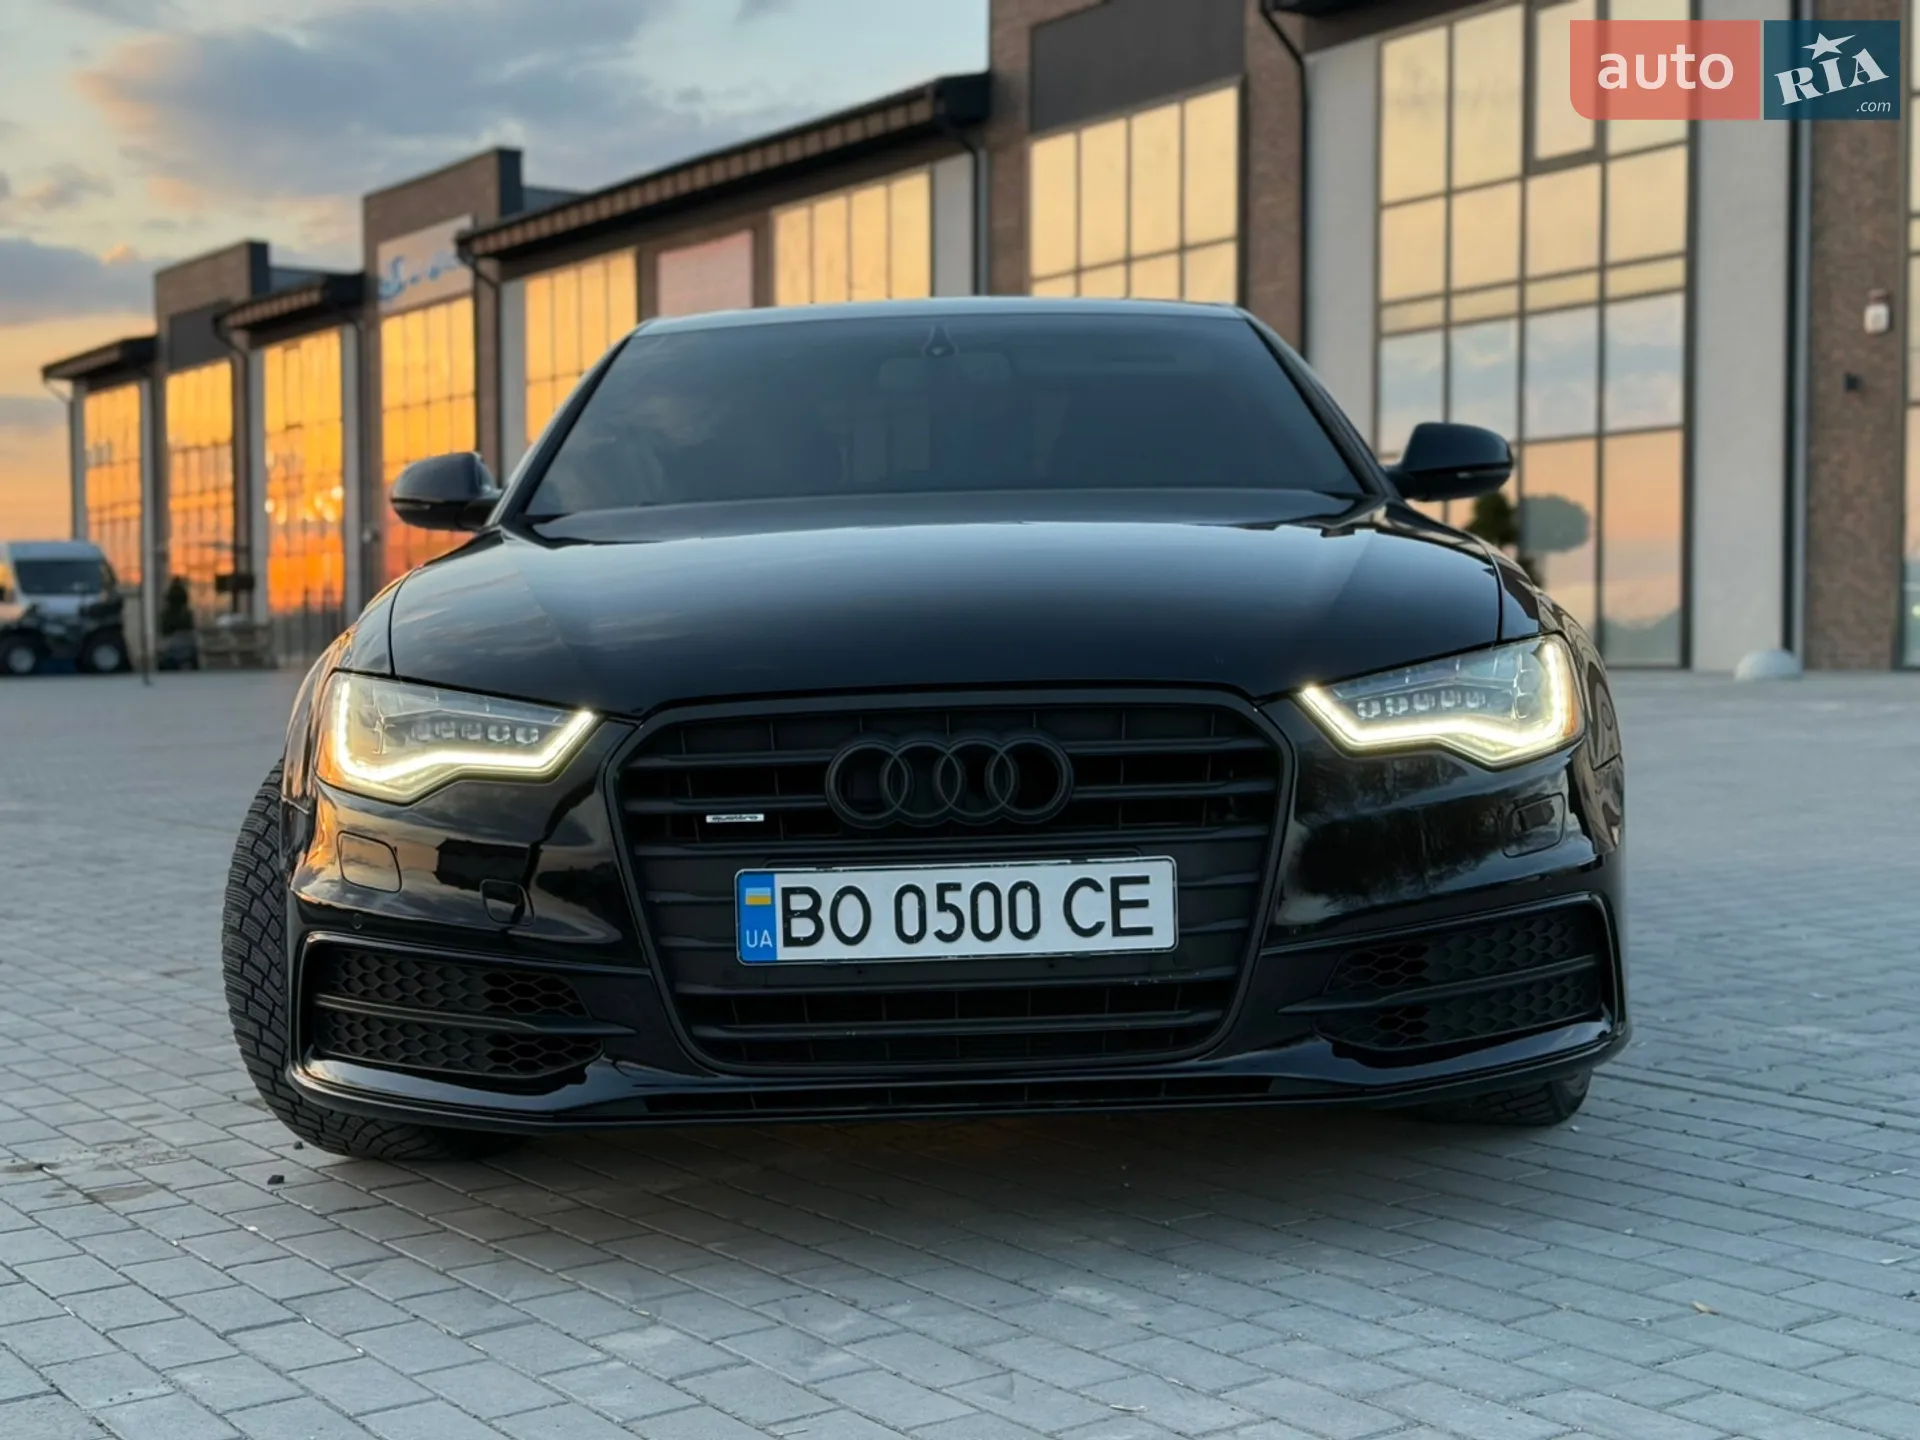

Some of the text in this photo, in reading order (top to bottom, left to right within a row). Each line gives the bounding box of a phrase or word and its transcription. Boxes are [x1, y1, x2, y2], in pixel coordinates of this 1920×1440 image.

[781, 875, 1154, 947] BO 0500 CE
[746, 929, 773, 948] UA
